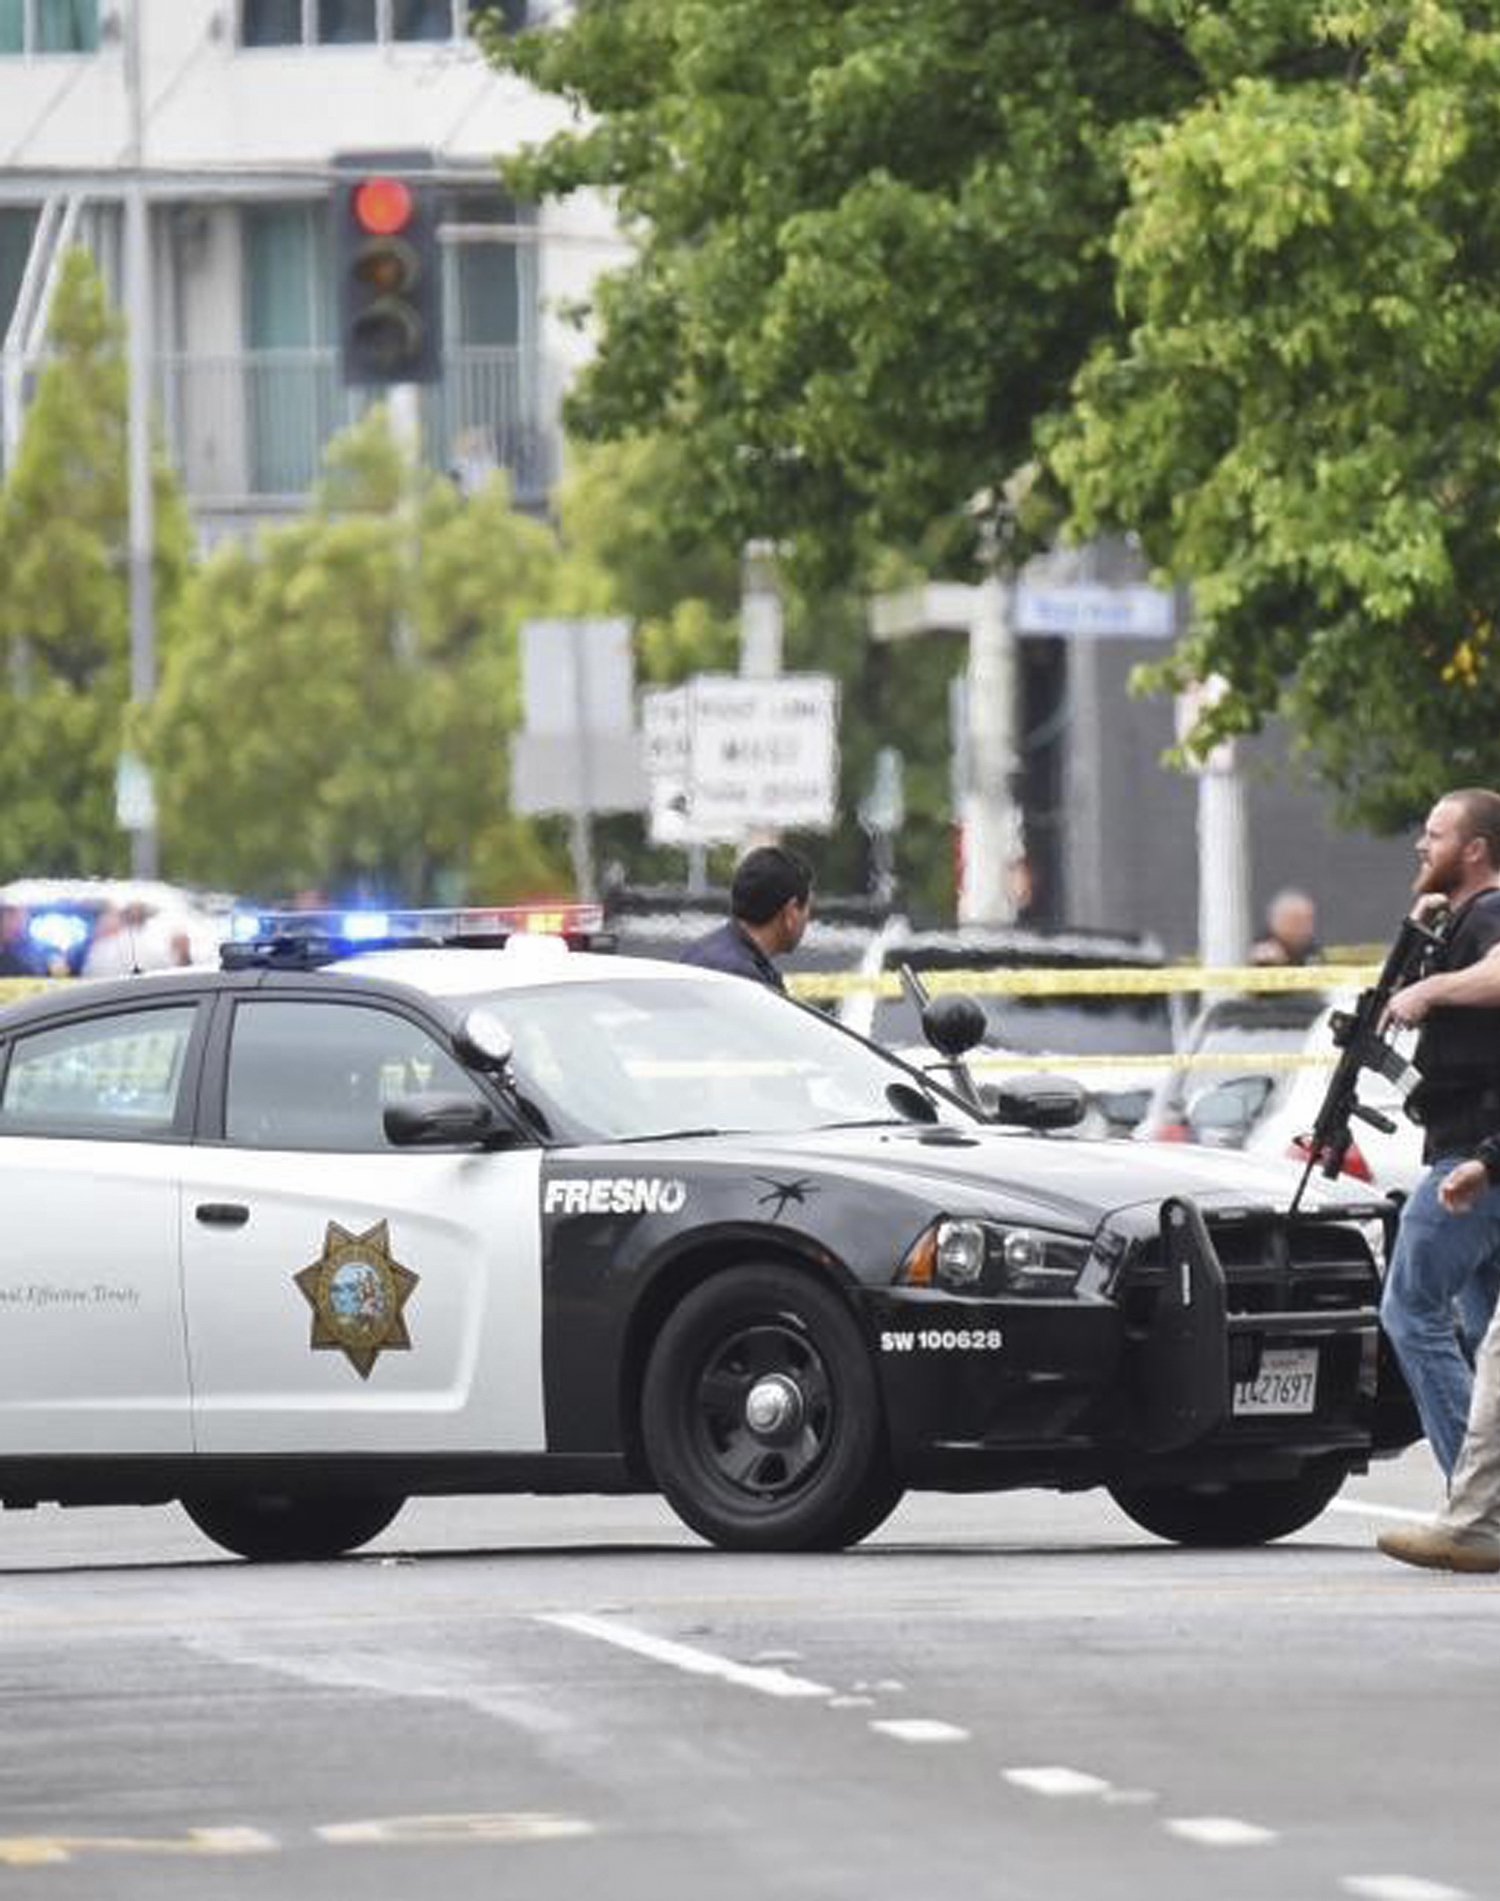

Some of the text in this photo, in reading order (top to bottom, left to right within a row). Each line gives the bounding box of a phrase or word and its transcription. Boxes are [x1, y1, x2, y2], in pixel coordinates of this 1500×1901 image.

[544, 1178, 687, 1214] FRESNO
[881, 1329, 1002, 1351] SW 100628
